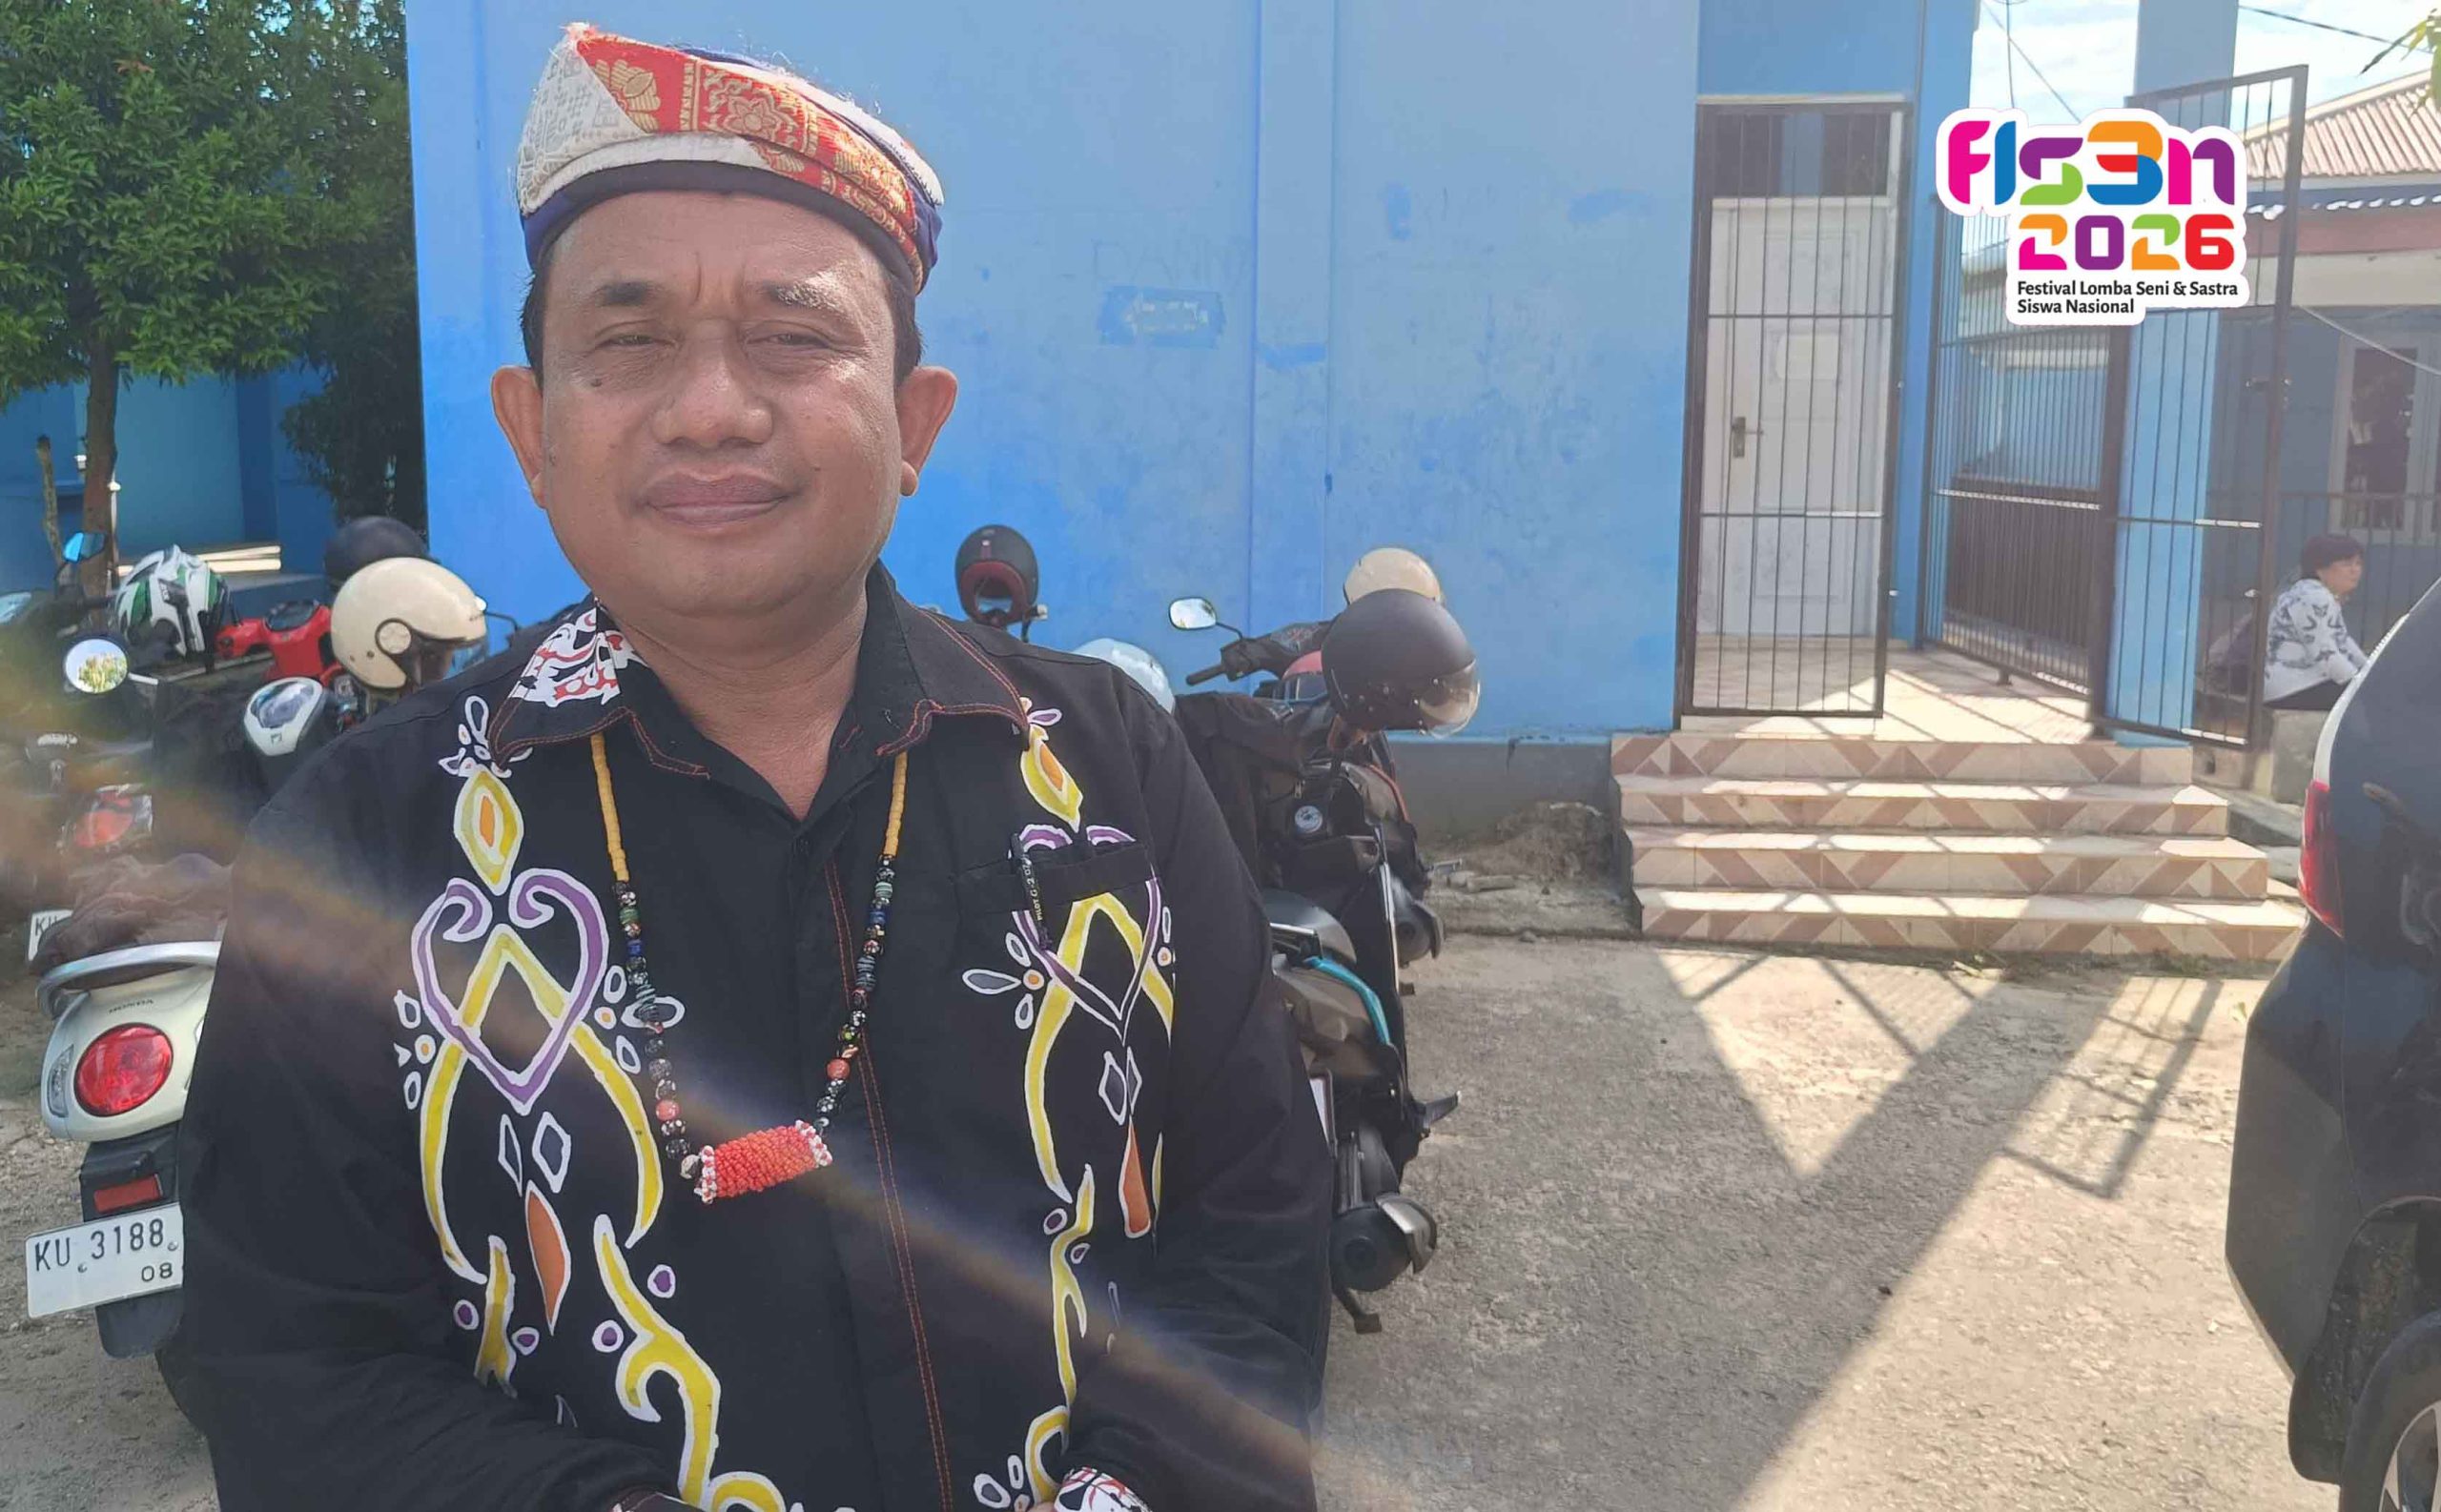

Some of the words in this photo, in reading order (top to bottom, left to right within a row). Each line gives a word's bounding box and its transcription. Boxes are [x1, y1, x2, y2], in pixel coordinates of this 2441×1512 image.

[34, 1237, 70, 1271] KU
[91, 1218, 163, 1259] 3188
[141, 1263, 173, 1282] 08
